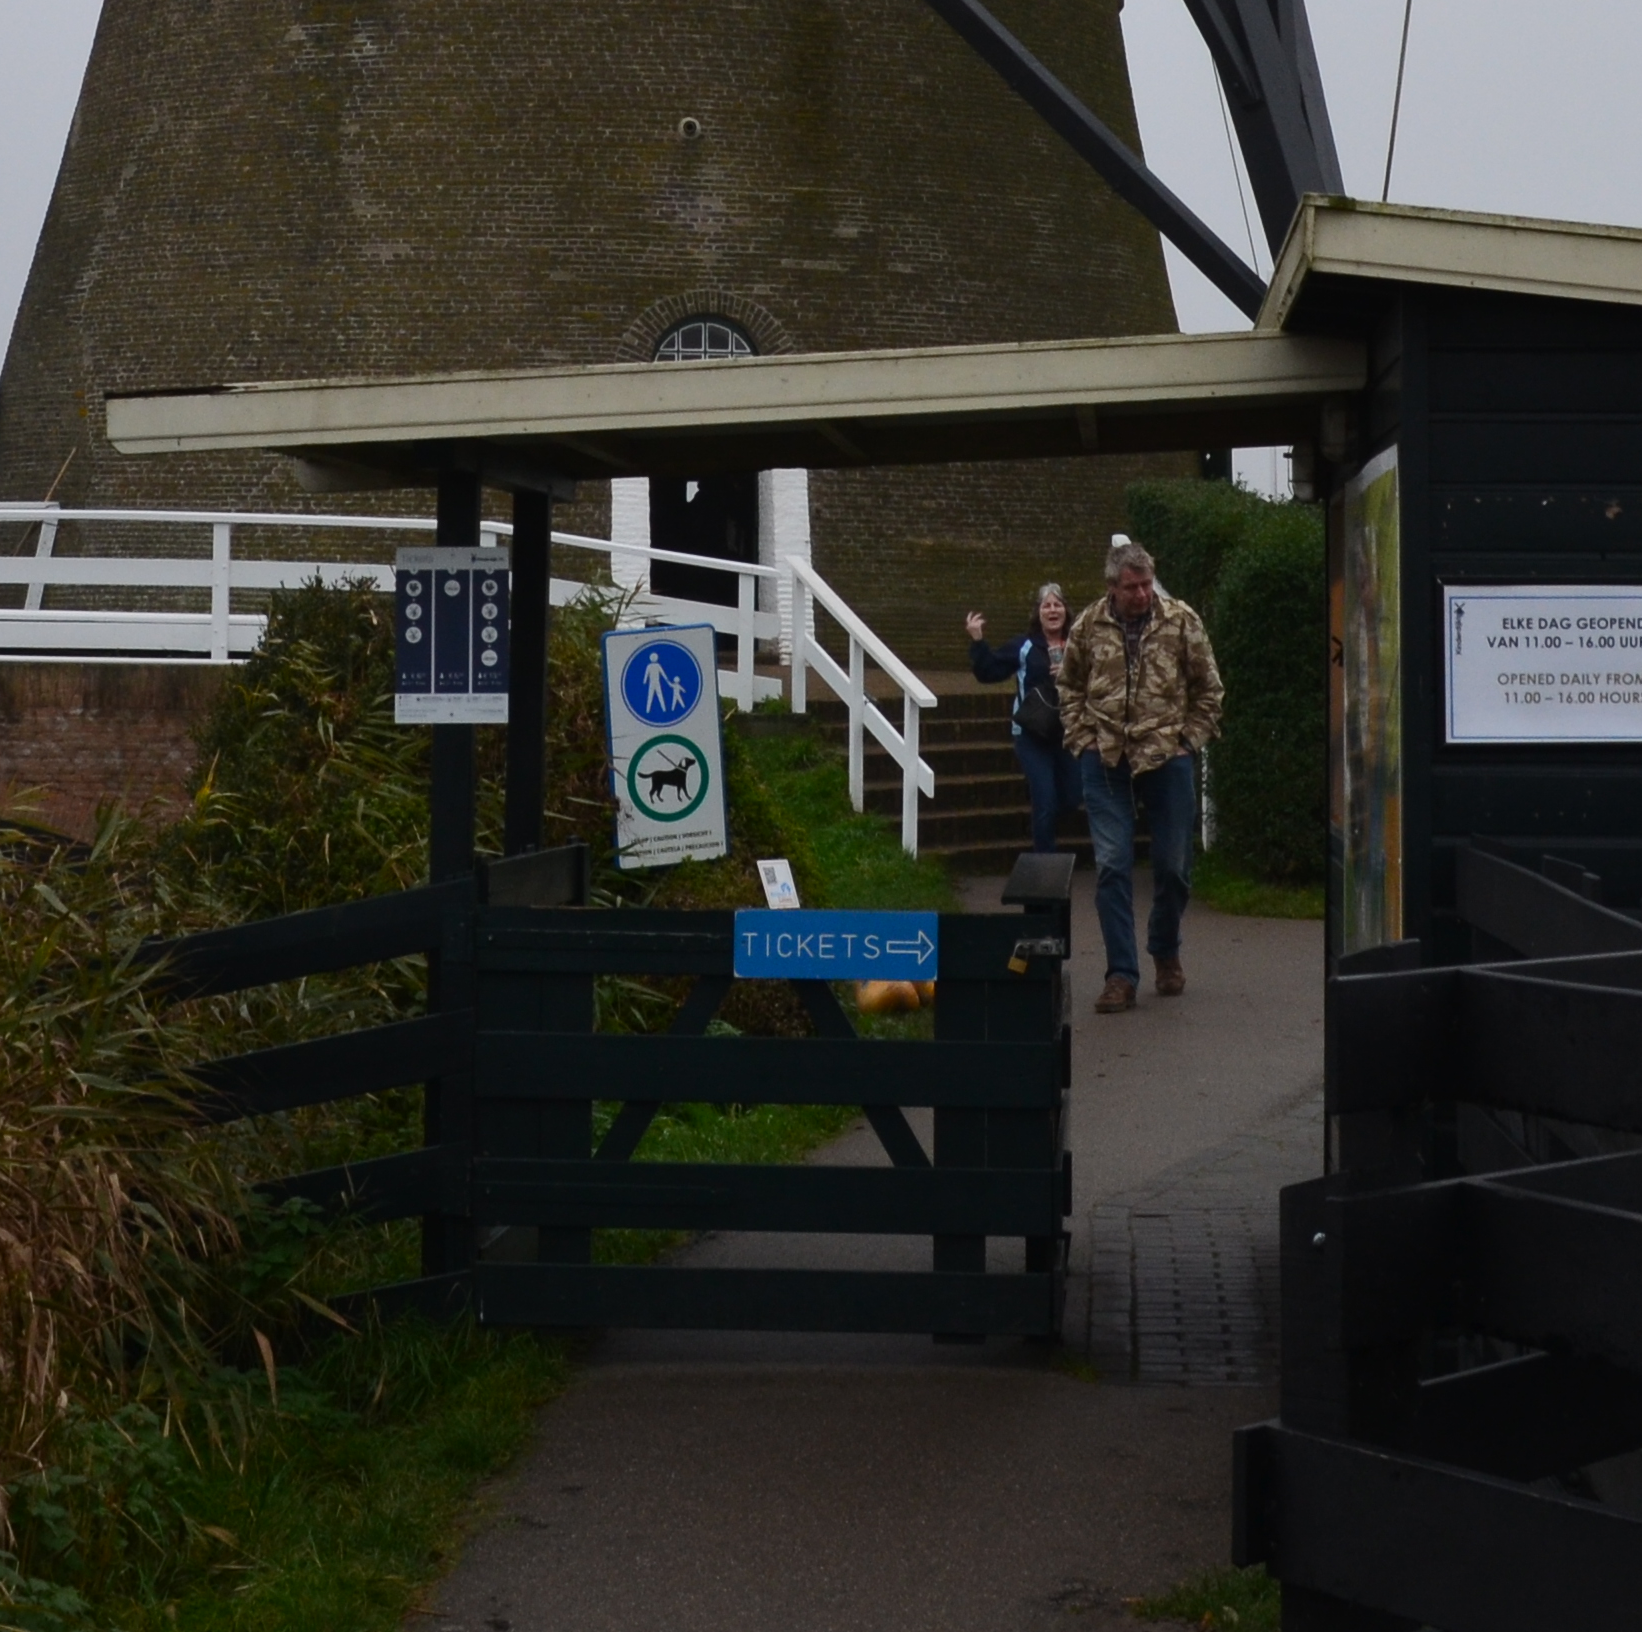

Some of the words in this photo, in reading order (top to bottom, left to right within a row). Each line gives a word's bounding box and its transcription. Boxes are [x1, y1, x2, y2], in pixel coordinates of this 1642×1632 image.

[1502, 617, 1533, 630] ELKE
[1538, 617, 1572, 630] DAG
[1486, 636, 1519, 648] VAN
[1524, 635, 1562, 649] 11.00
[1578, 635, 1616, 649] 16.00
[1497, 672, 1556, 686] OPENED
[1560, 672, 1601, 686] DAILY
[1504, 691, 1542, 704] 11.00
[1558, 691, 1595, 705] 16.00
[742, 932, 881, 960] TICKETS
